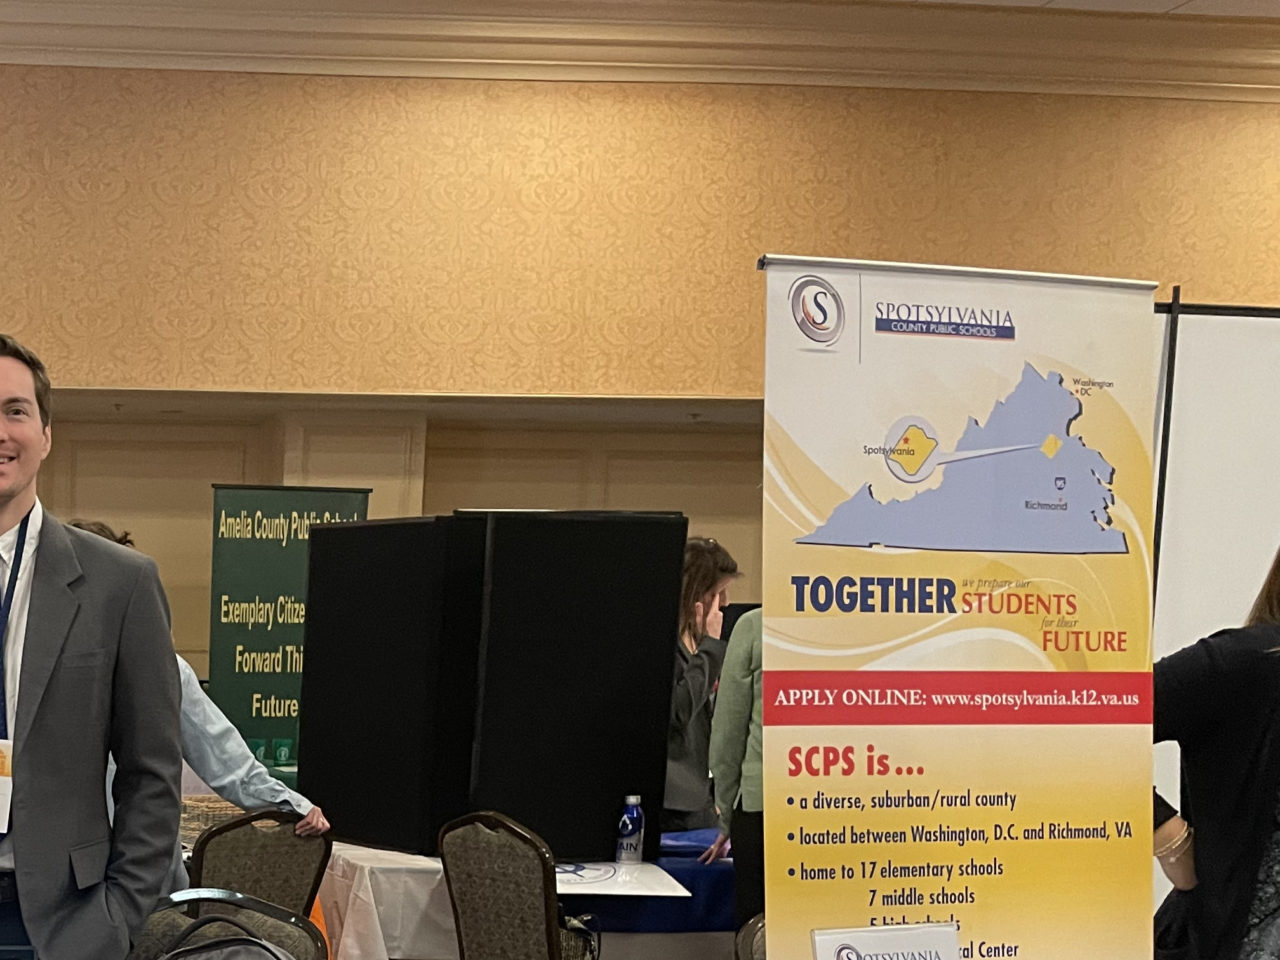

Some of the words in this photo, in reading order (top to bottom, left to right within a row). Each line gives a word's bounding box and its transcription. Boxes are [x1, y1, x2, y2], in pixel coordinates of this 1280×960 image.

[875, 302, 1015, 327] SPOTSYLVANIA
[891, 321, 926, 333] COUNTY
[930, 324, 957, 335] PUBLIC
[959, 326, 997, 338] SCHOOLS
[1073, 377, 1114, 389] Washington
[1080, 387, 1092, 397] DC
[863, 446, 915, 457] Spotsylvania
[1025, 501, 1068, 511] Richmond
[219, 509, 252, 539] Amelia
[254, 511, 289, 547] County
[791, 575, 958, 614] TOGETHER
[977, 579, 1012, 591] prepare
[221, 595, 275, 630] Exemplary
[962, 592, 1078, 615] STUDENTS
[1056, 617, 1079, 628] their
[1042, 631, 1127, 652] FUTURE
[235, 645, 282, 673] Forward
[252, 693, 299, 718] Future
[774, 689, 836, 706] APPLY
[842, 689, 927, 706] ONLINE:
[931, 689, 1139, 710] www.spotsylvania.k12.va.us
[787, 746, 855, 777] SCPS
[866, 745, 925, 776] is...
[799, 797, 808, 809] a
[813, 791, 866, 812] diverse,
[870, 788, 970, 812] suburban/rural
[975, 791, 1017, 811] county
[799, 826, 846, 845] located
[850, 825, 907, 844] between
[911, 824, 989, 846] Washington,
[994, 824, 1019, 841] D.C.
[1023, 822, 1045, 840] and
[1049, 821, 1111, 841] Richmond,
[1115, 821, 1133, 838] VA
[800, 862, 836, 880] home
[841, 864, 855, 879] to
[861, 861, 877, 879] 17
[880, 859, 954, 882] elementary
[958, 857, 1004, 876] schools
[869, 889, 878, 907] 7
[882, 887, 924, 906] middle
[929, 885, 975, 905] schools
[978, 942, 1019, 958] Center
